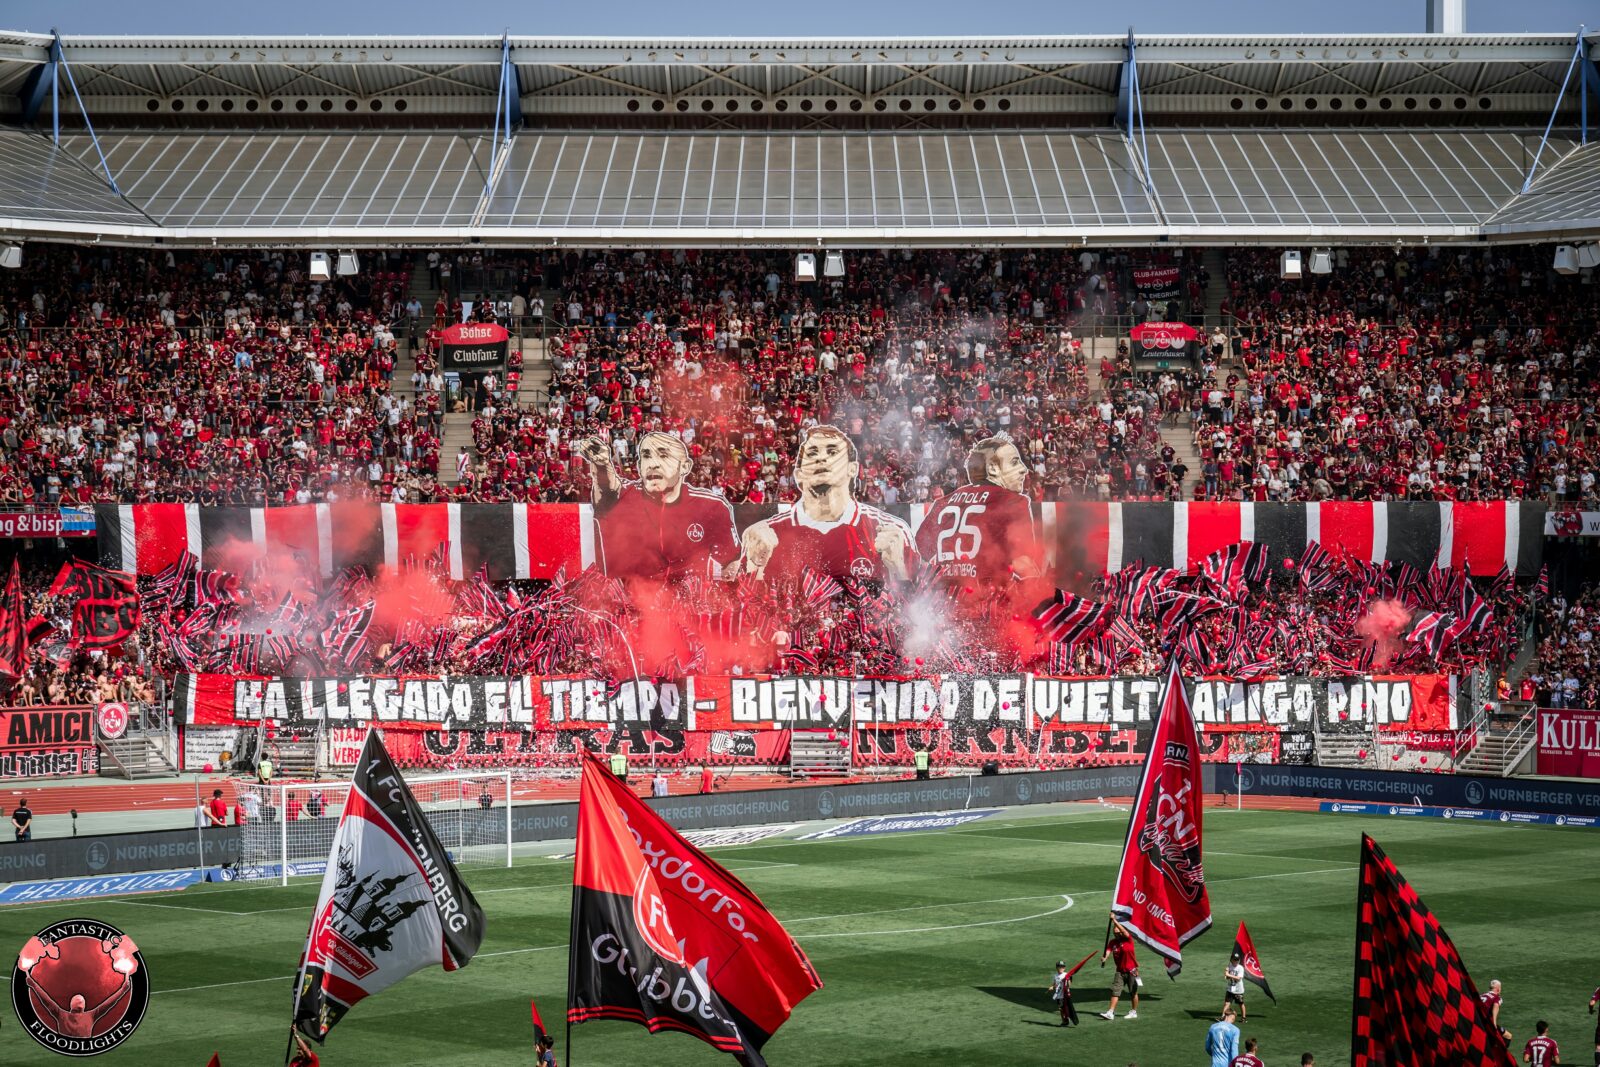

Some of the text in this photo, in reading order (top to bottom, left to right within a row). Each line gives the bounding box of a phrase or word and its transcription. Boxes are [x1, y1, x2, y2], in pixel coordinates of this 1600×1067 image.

[459, 327, 492, 339] Böhse
[453, 349, 498, 362] Clubfanz
[948, 491, 990, 504] PINOLA
[17, 514, 30, 531] &
[937, 504, 987, 562] 25
[235, 681, 288, 720] HA
[300, 679, 472, 722] LLEGADO
[484, 680, 533, 722] EL
[542, 679, 680, 722] TIEMPO
[731, 679, 960, 723] BIENVENIDO
[974, 679, 1021, 721] DE
[1034, 680, 1163, 723] VUELT
[1192, 682, 1313, 724] AMIGO
[1327, 682, 1411, 723] PINO
[7, 711, 91, 745] AMICI
[736, 742, 754, 752] 1994
[1036, 777, 1101, 794] NÜRNBERGER
[1260, 774, 1434, 796] NÜRNBERGER VERSICHERUNG
[839, 786, 991, 808] NÜRNBERGER VERSICHERUNG
[1489, 788, 1573, 805] NÜRNBERGER
[706, 800, 790, 818] VERSICHERUNG
[116, 840, 213, 861] NÜRNBERGER
[13, 872, 193, 900] HELMSAUER
[1532, 1045, 1547, 1066] 17
